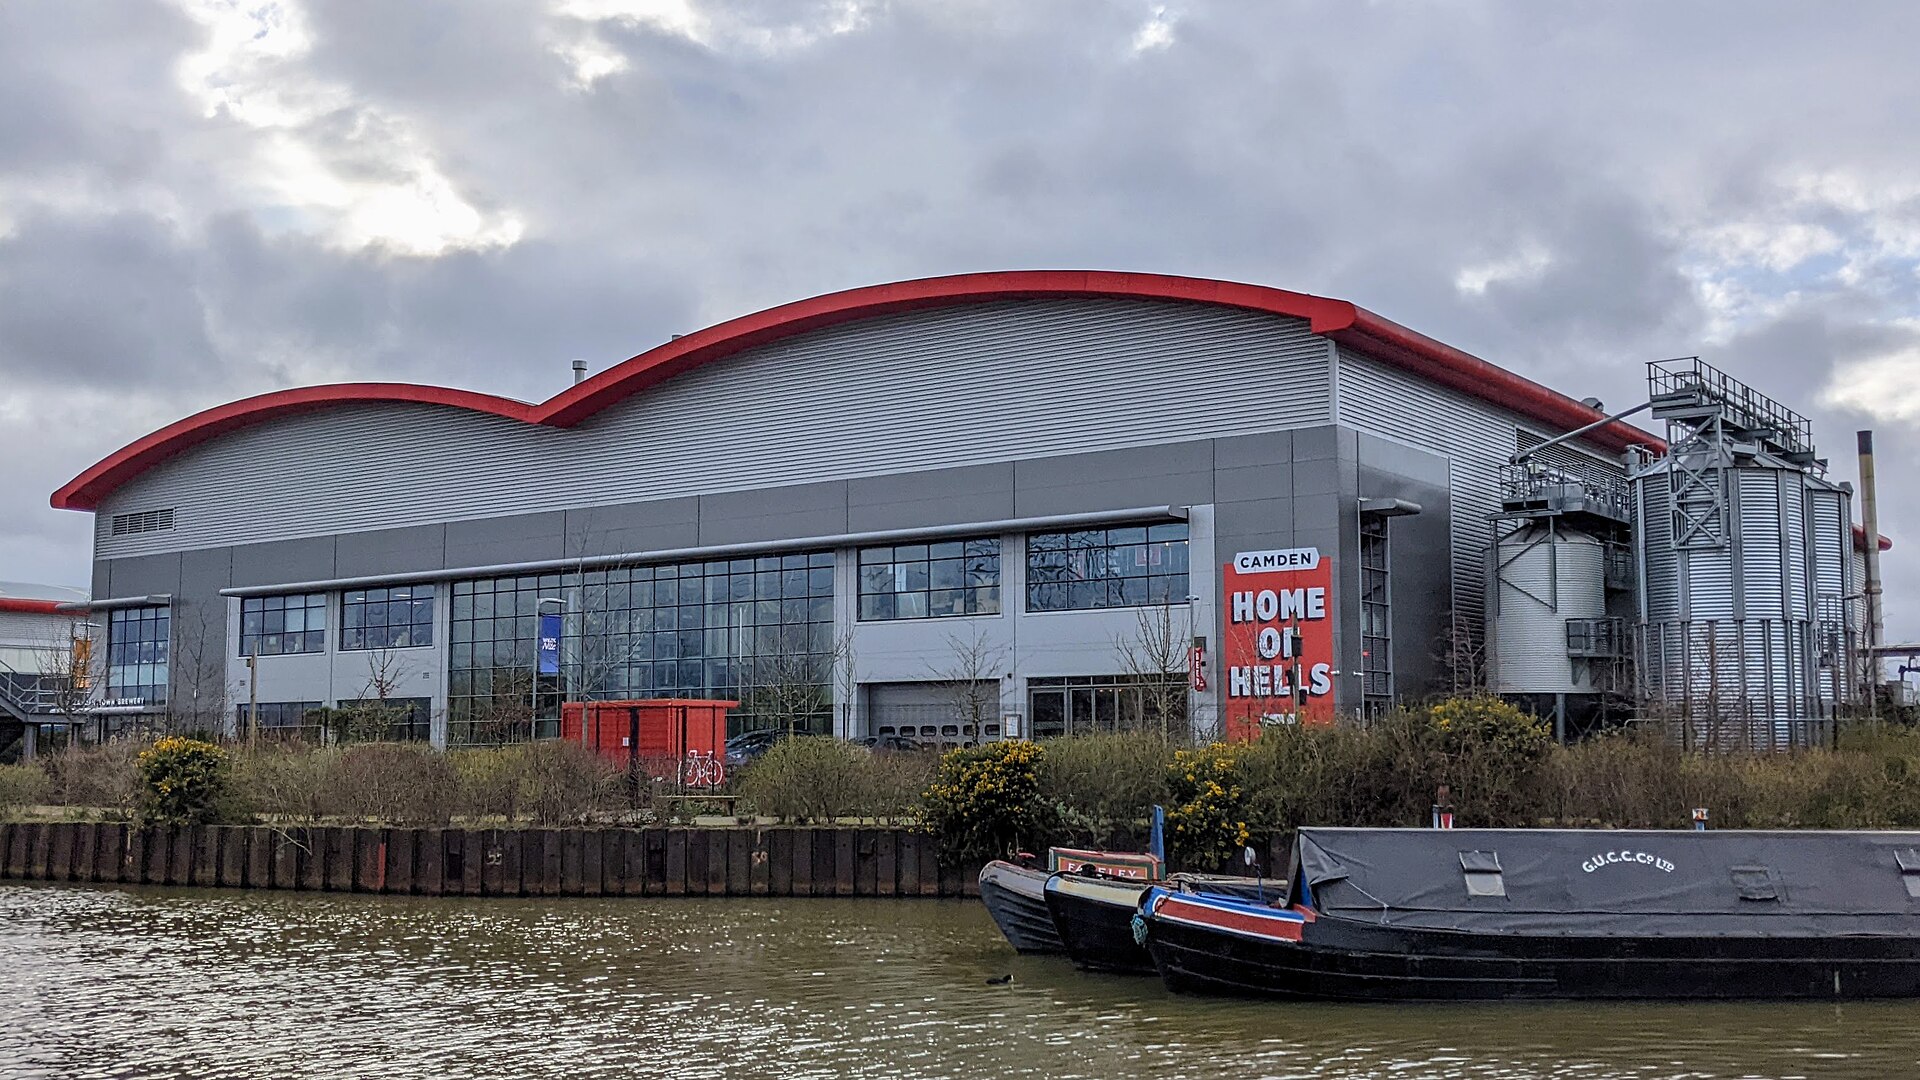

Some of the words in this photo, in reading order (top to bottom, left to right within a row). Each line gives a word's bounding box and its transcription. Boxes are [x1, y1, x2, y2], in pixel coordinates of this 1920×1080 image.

[1240, 552, 1312, 569] CAMDEN
[1232, 587, 1326, 622] HOME
[1067, 862, 1137, 877] FAELEY
